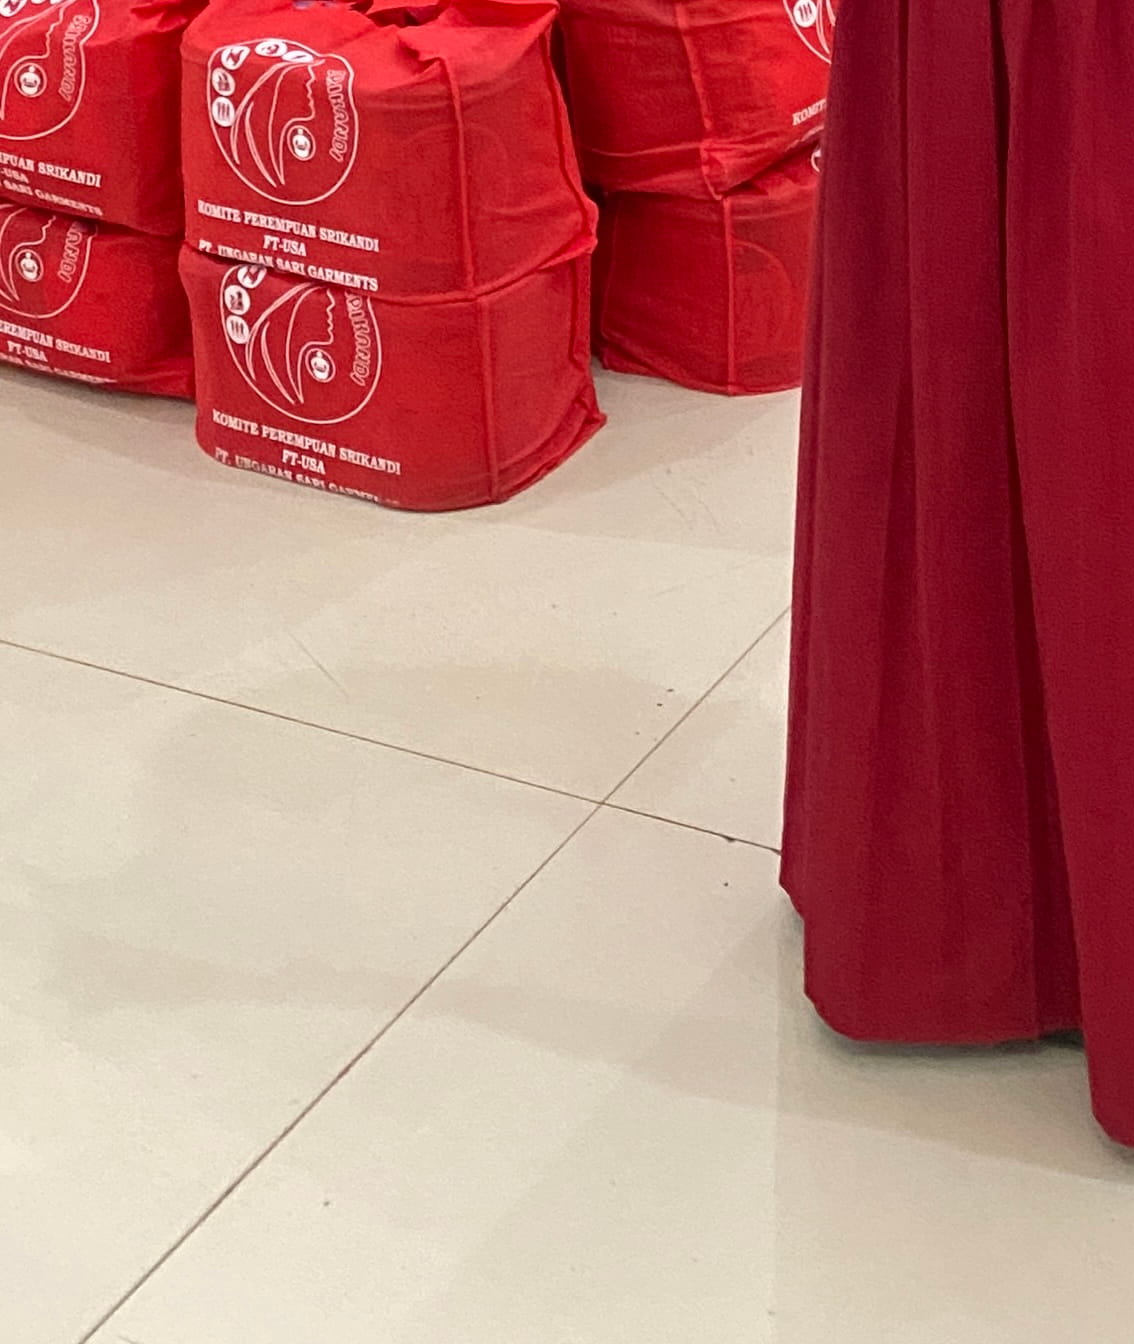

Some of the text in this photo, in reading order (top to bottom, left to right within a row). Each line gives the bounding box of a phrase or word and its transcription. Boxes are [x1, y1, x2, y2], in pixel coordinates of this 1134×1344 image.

[38, 161, 101, 188] SRIKANDI
[197, 199, 380, 253] KOMITE PEREMPUAN SRIKANDI
[263, 234, 307, 257] FT-USA
[307, 264, 379, 292] GARMENTS
[7, 340, 48, 363] FT-USA
[55, 338, 111, 364] SRIKANDI
[213, 408, 401, 476] KOMITE PEREMPUAN SRIKANDI
[282, 448, 326, 475] FT-USA
